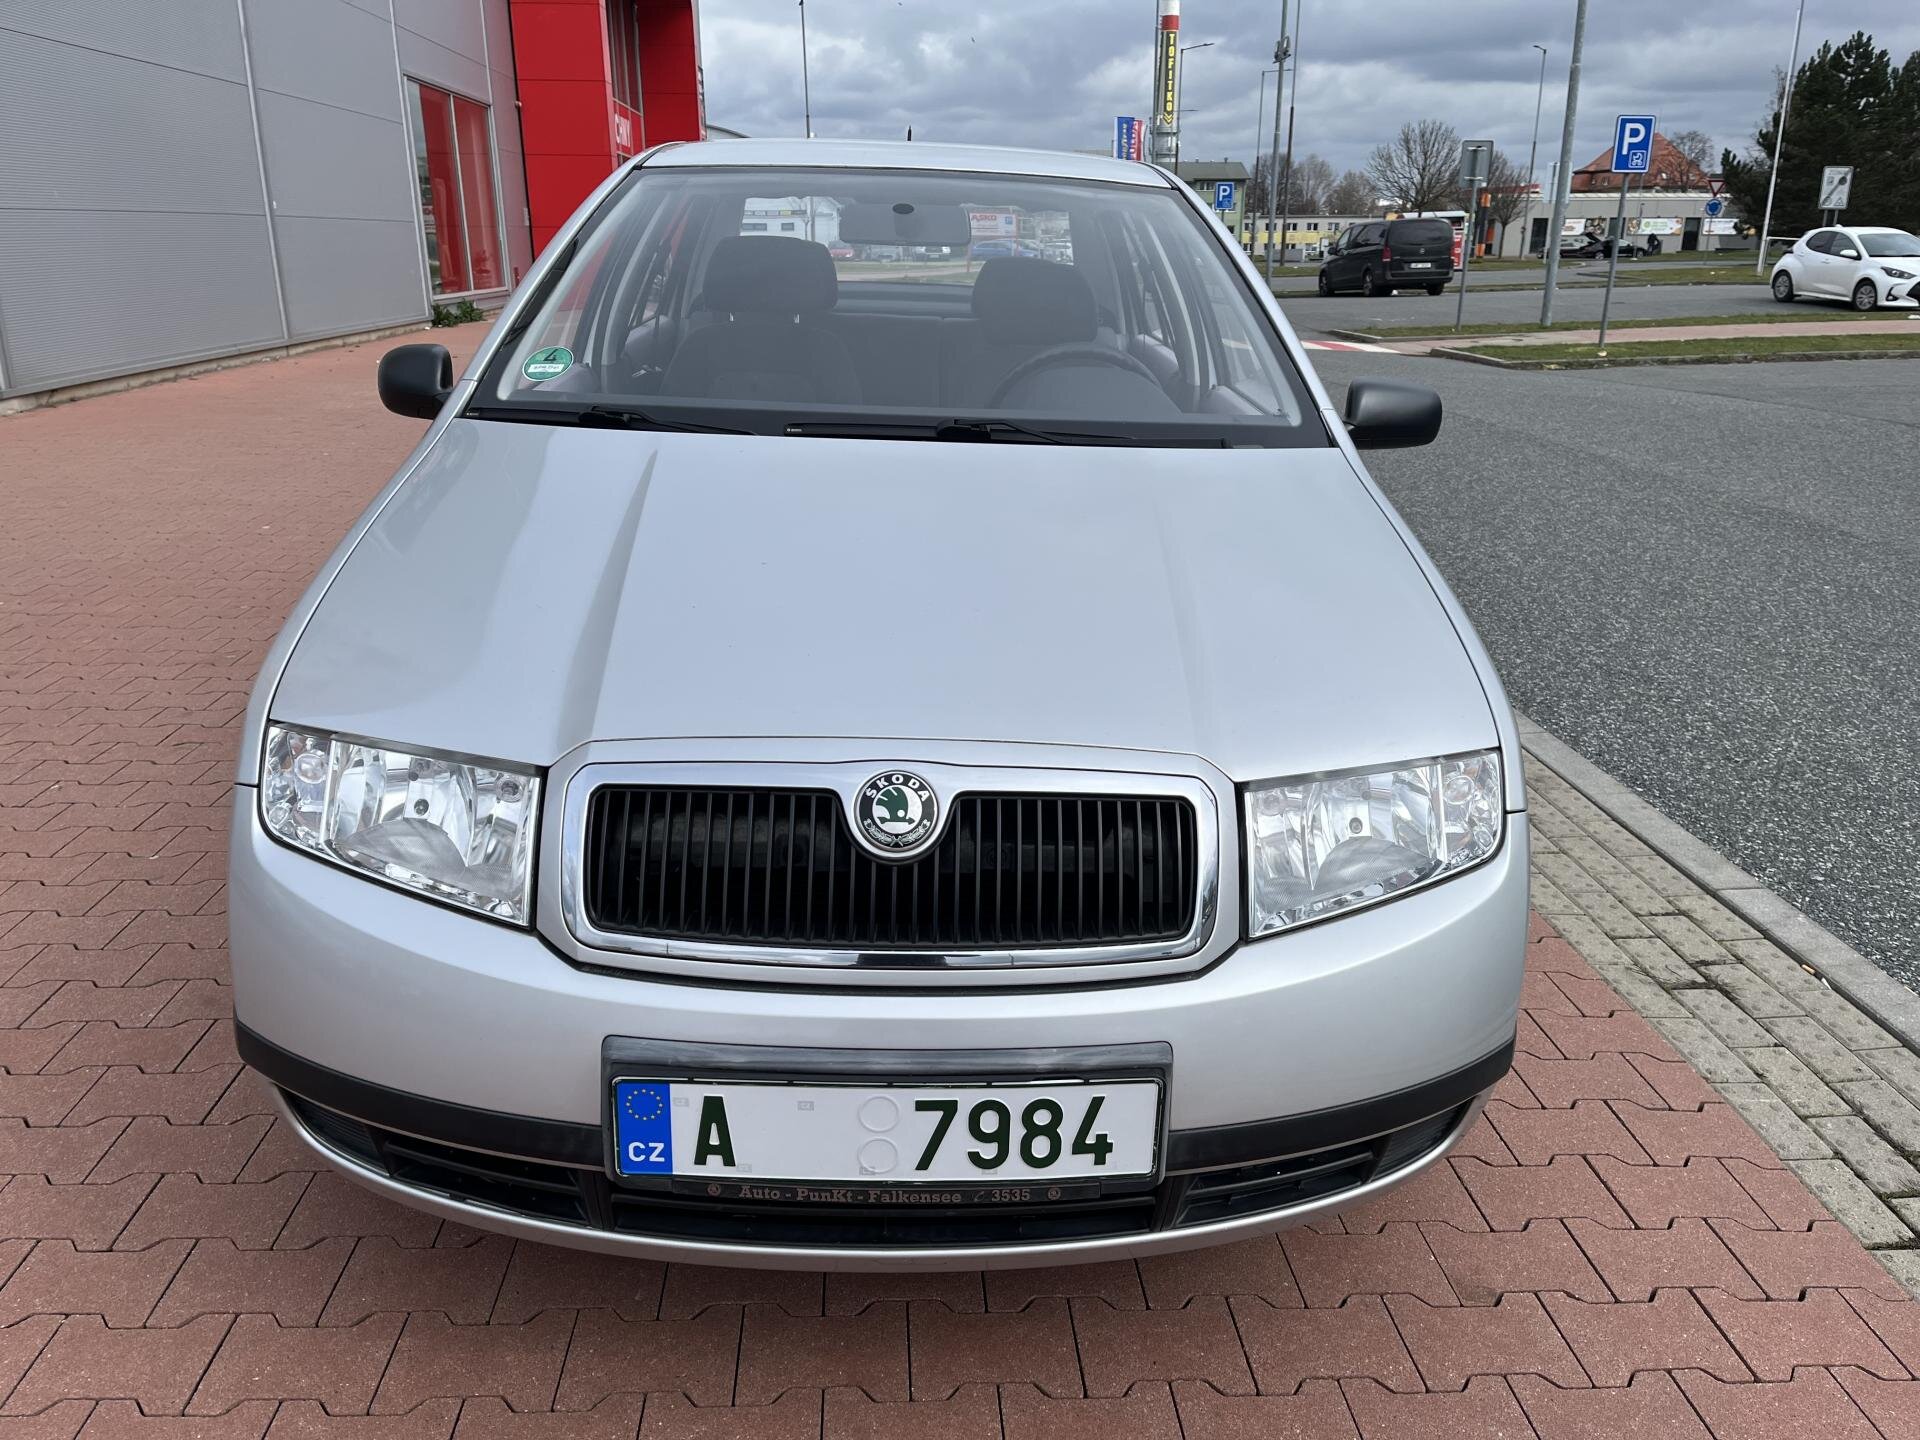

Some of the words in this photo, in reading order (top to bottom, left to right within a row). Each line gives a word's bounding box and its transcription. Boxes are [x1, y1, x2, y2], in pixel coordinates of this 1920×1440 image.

[1622, 123, 1646, 155] P
[1219, 185, 1230, 201] P
[694, 1095, 736, 1167] A
[915, 1095, 1114, 1170] 7984
[628, 1141, 665, 1162] CZ
[739, 1185, 780, 1200] Auto
[868, 1190, 962, 1204] Falkensee
[991, 1188, 1031, 1202] 3535
